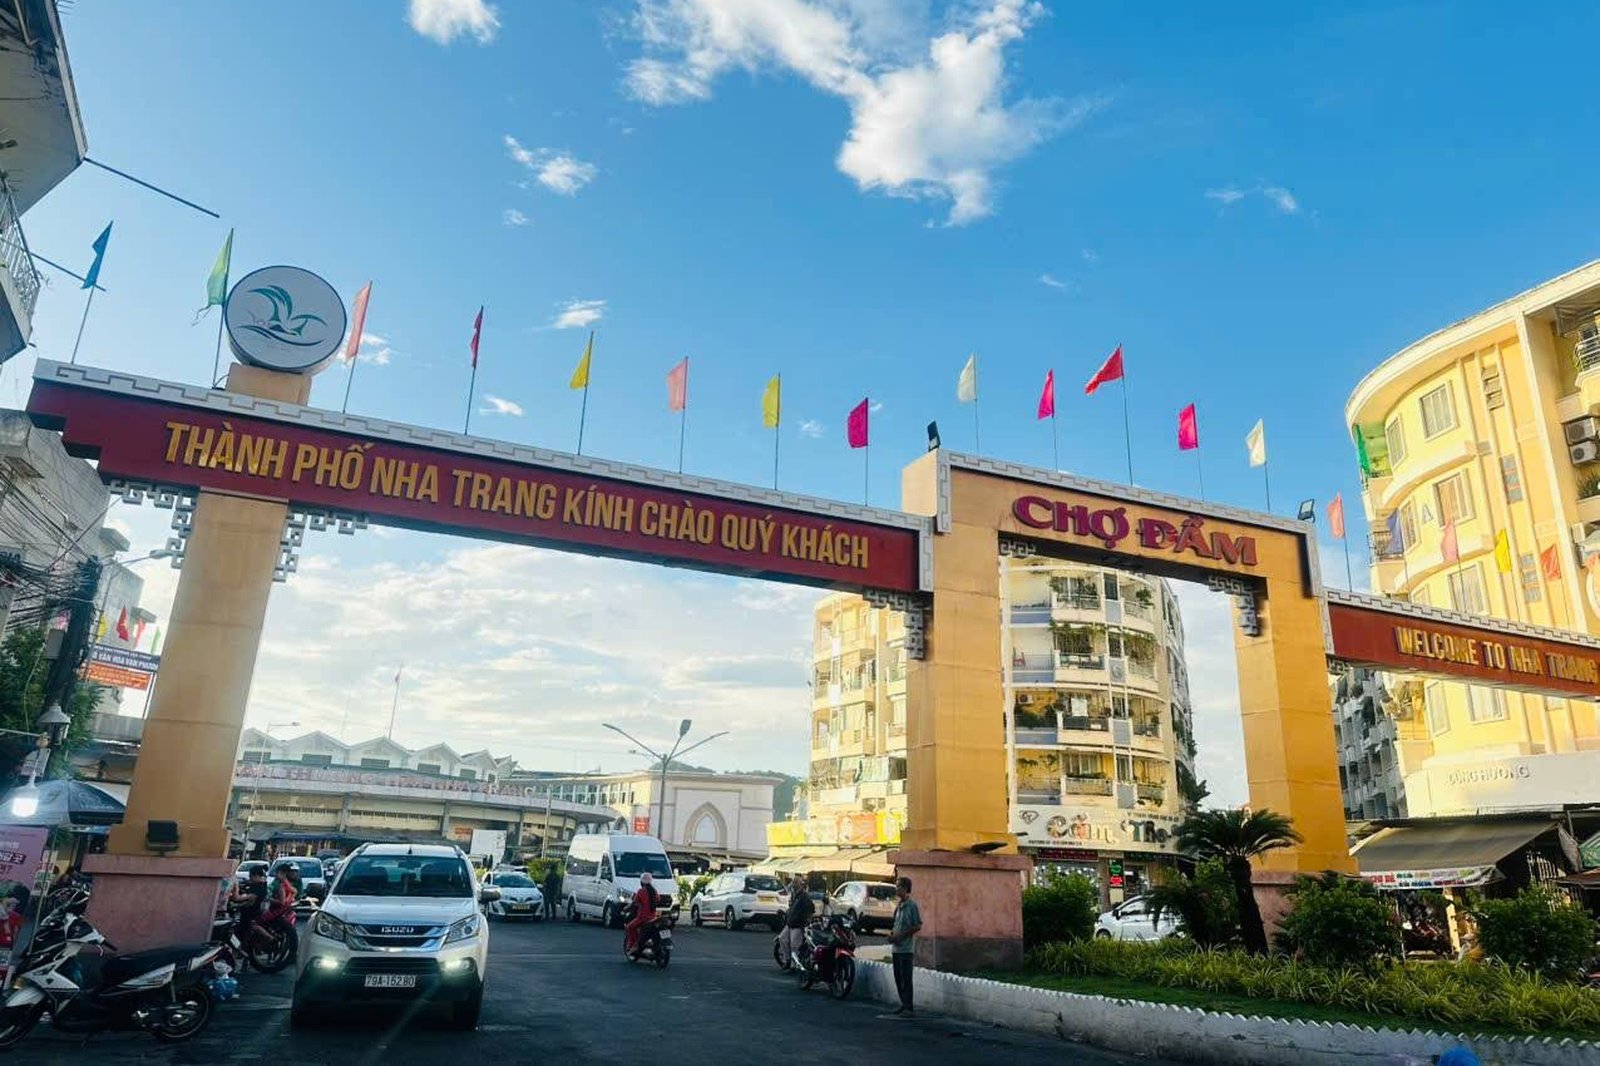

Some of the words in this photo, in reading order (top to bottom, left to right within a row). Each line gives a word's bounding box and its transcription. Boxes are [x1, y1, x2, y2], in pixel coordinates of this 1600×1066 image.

[165, 420, 288, 479] THÀNH
[292, 442, 374, 490] PHỐ
[370, 456, 439, 502] NHA
[452, 469, 557, 520] TRANG
[562, 484, 634, 532] KÍNH
[640, 500, 714, 545] CHÀO
[721, 514, 776, 553] QUÝ
[782, 524, 869, 569] KHÁCH
[1012, 496, 1130, 549] CHỢ
[1393, 626, 1479, 665] WELCOME
[1482, 641, 1505, 669] TO
[1508, 645, 1544, 675] NHA
[1546, 652, 1599, 684] TRANG
